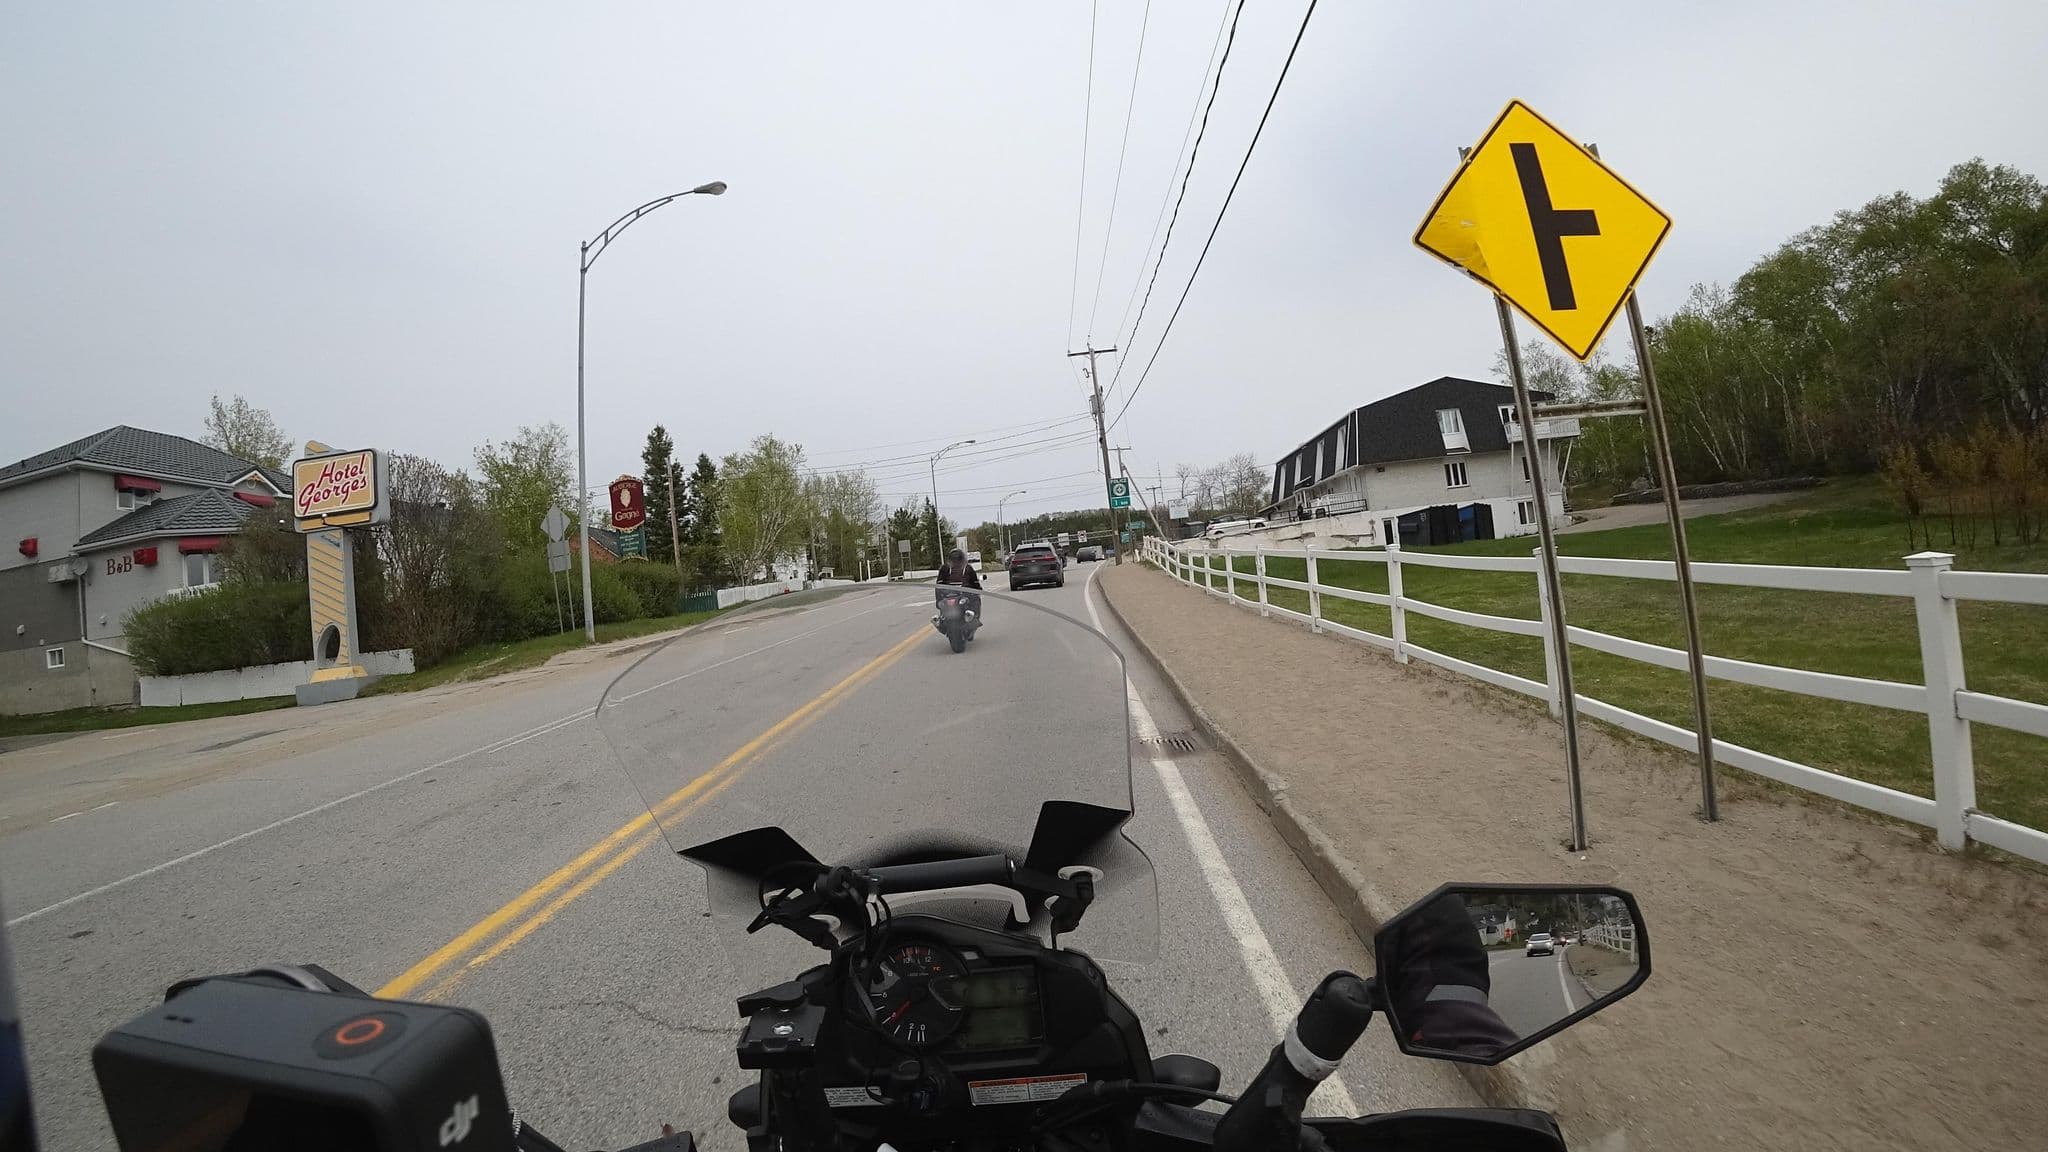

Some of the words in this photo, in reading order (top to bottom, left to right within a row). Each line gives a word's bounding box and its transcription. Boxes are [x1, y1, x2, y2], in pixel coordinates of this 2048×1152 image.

[315, 452, 367, 489] Hotel
[298, 475, 368, 516] Georges
[909, 1022, 915, 1030] 2
